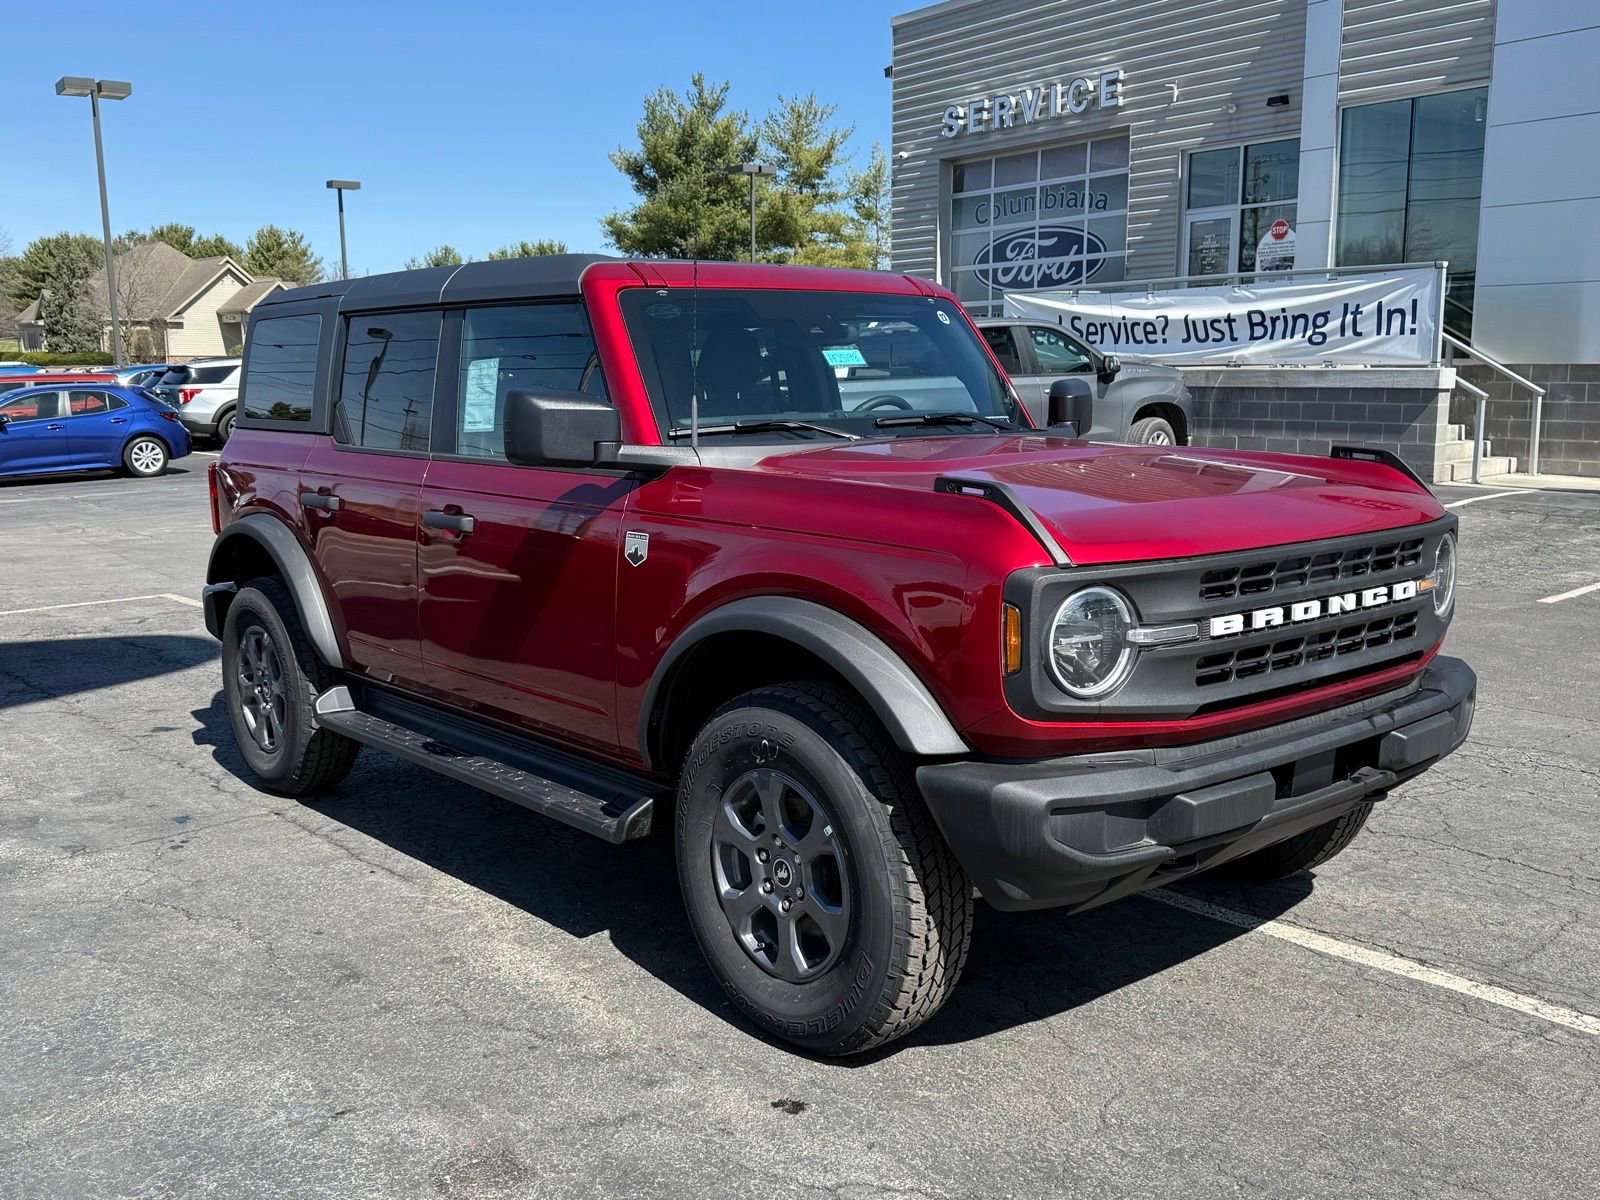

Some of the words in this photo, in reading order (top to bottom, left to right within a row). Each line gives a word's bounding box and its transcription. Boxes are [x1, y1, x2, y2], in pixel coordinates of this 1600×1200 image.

[942, 70, 1124, 138] SERVICE
[975, 187, 1108, 224] Columbiana
[1272, 226, 1288, 235] STOP
[997, 237, 1079, 284] Ford
[1070, 315, 1169, 345] Service?
[1182, 313, 1239, 344] Just
[1247, 308, 1330, 346] Bring
[1339, 303, 1363, 337] It
[1376, 299, 1418, 336] In!
[1209, 580, 1417, 637] BRONCO
